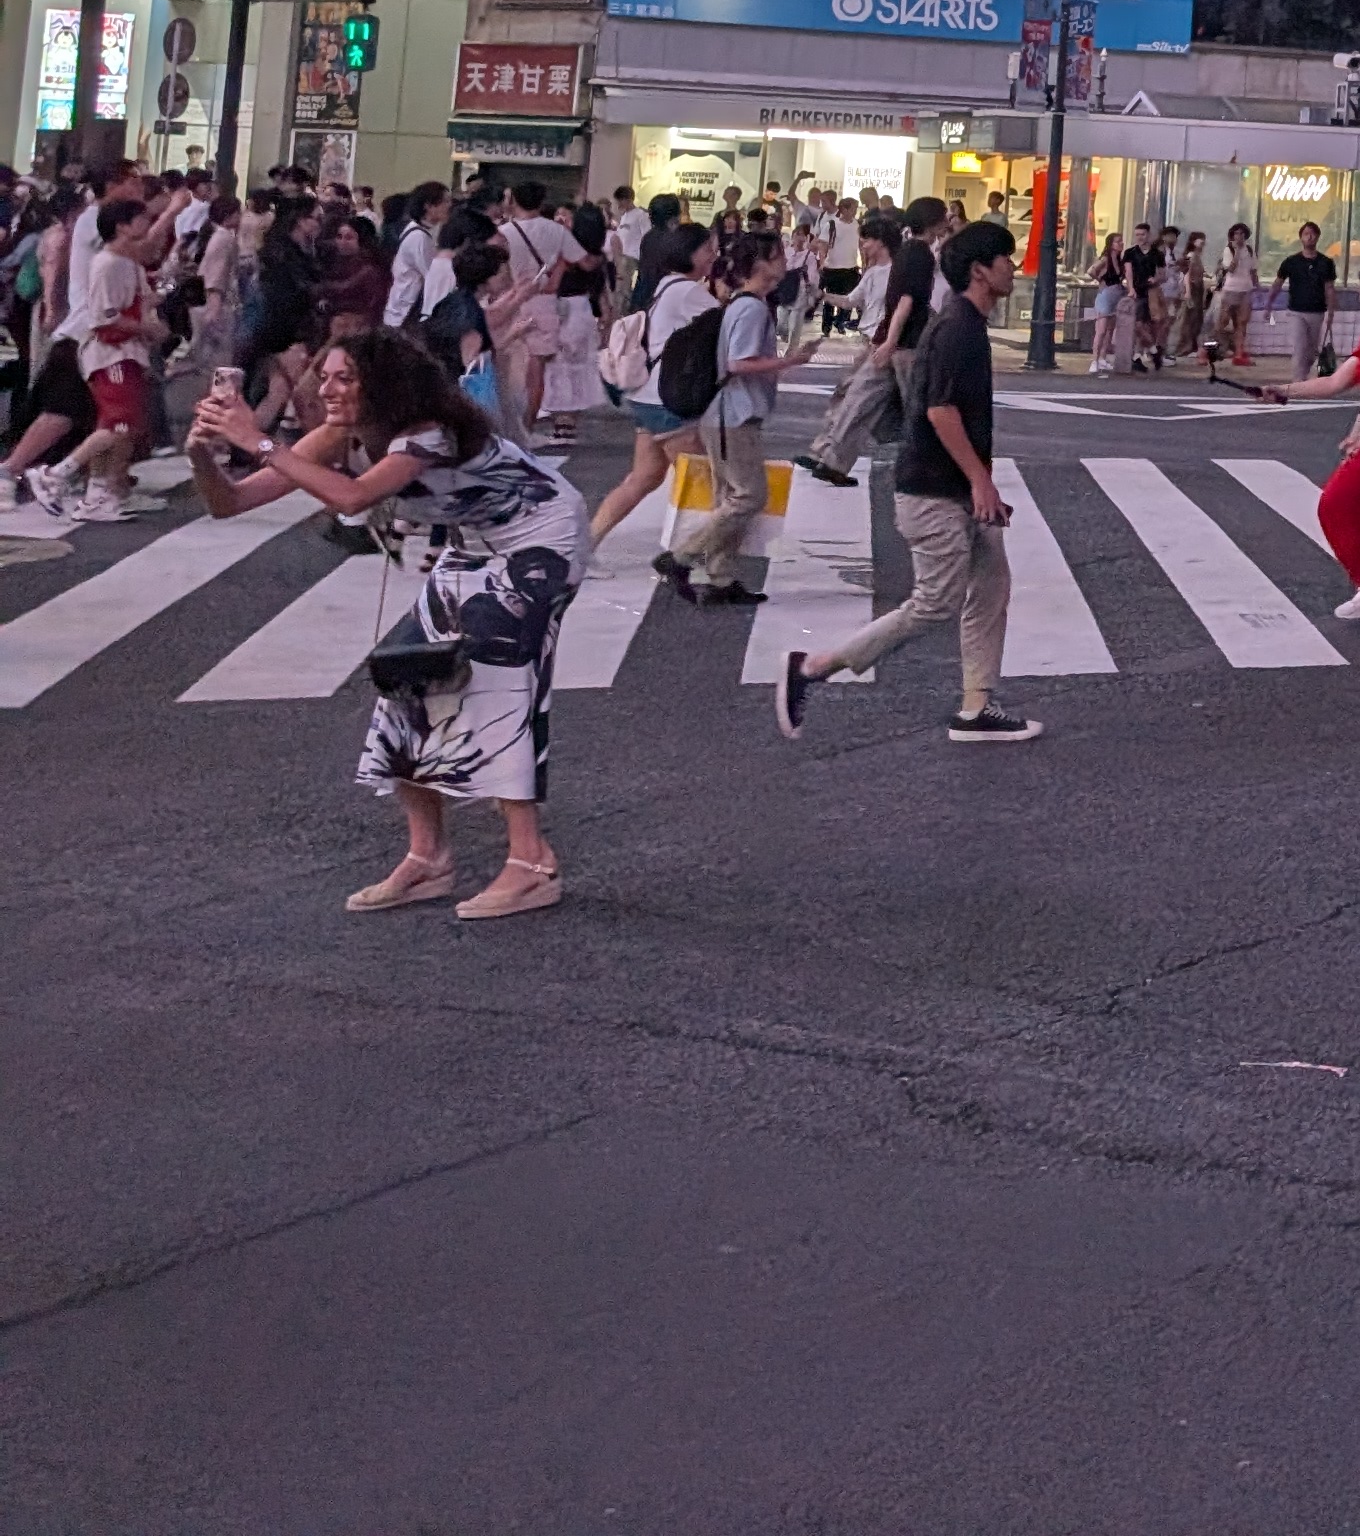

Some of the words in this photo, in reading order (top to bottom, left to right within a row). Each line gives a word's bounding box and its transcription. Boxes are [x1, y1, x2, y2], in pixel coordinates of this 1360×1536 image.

[463, 62, 574, 97] 天津甘栗
[759, 108, 894, 134] BLACKEYEPATCH
